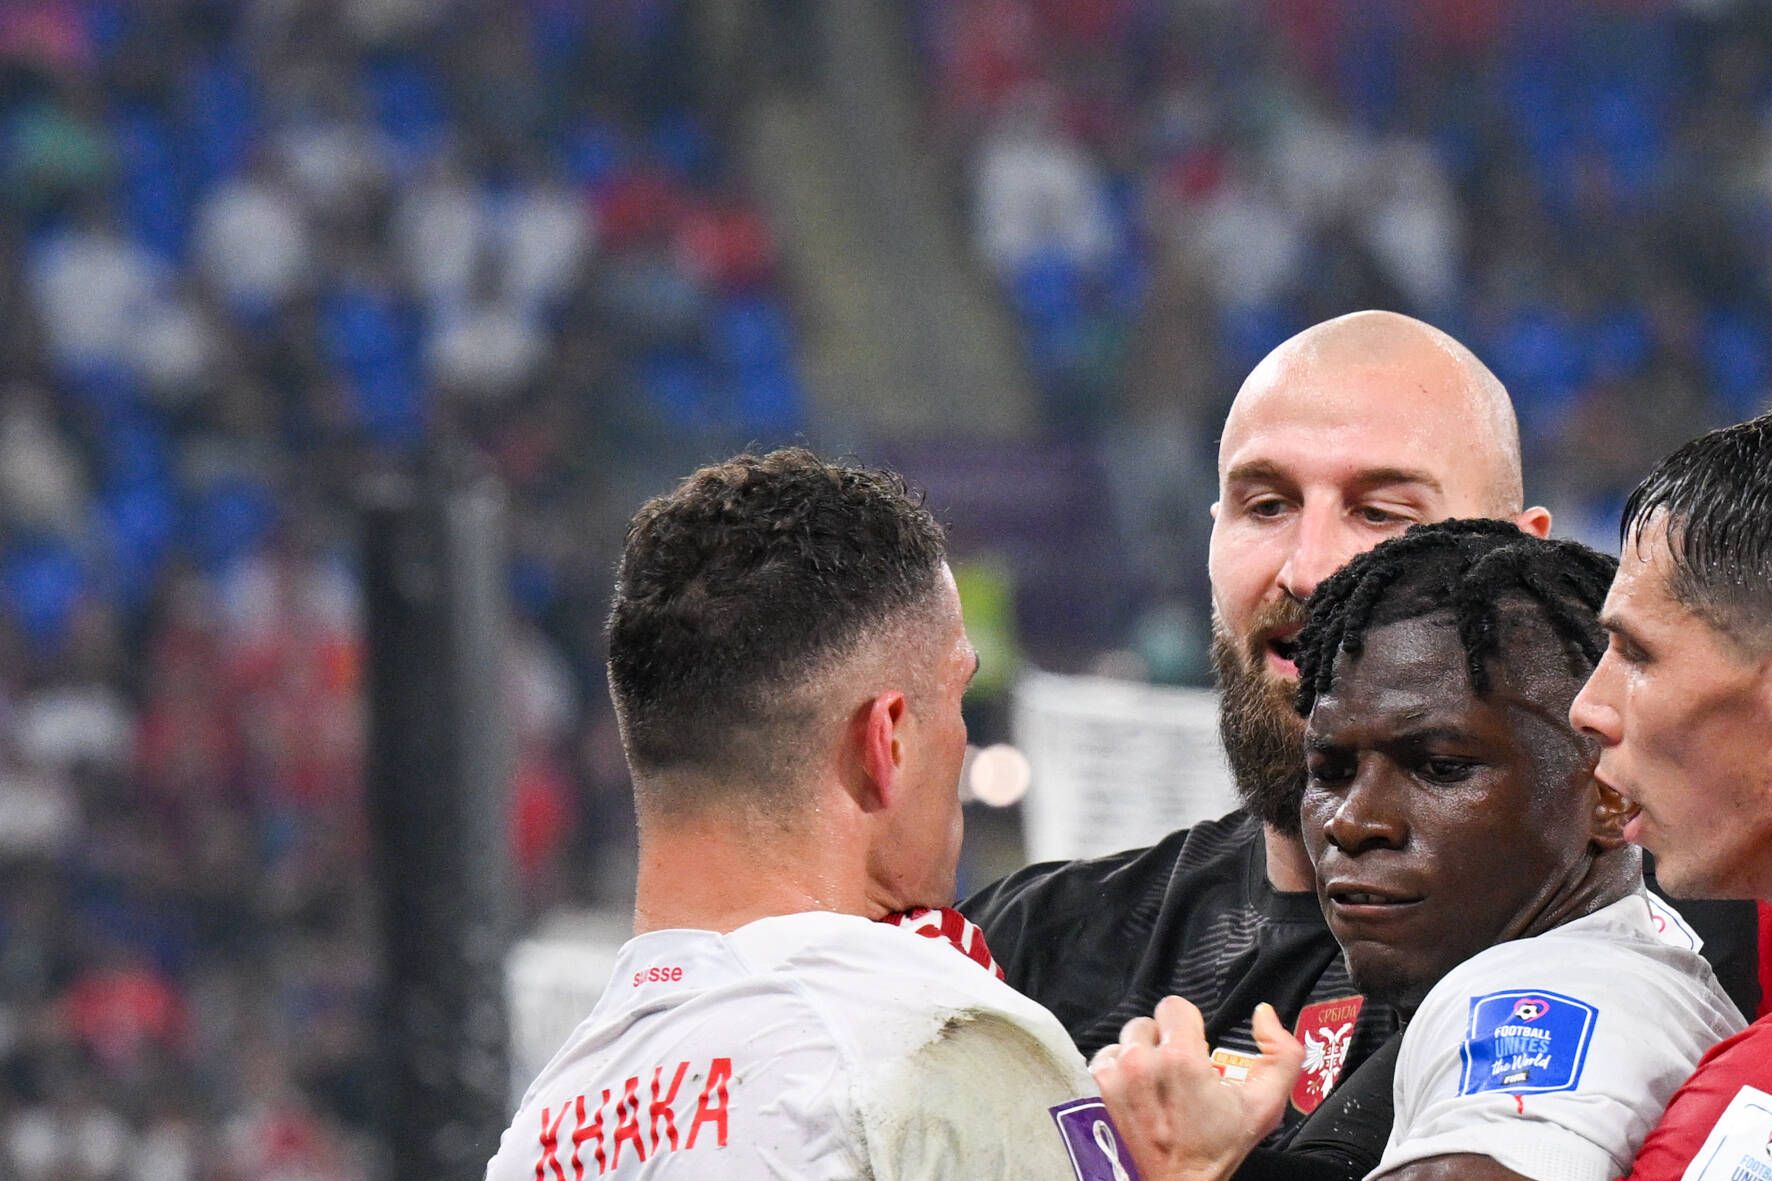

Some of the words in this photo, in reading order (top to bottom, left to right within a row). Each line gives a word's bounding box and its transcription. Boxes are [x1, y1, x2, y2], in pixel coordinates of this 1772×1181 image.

[633, 967, 682, 987] ssse
[1494, 1025, 1551, 1040] FOOTBALL
[1495, 1036, 1550, 1057] UNITES
[1512, 1053, 1551, 1070] World
